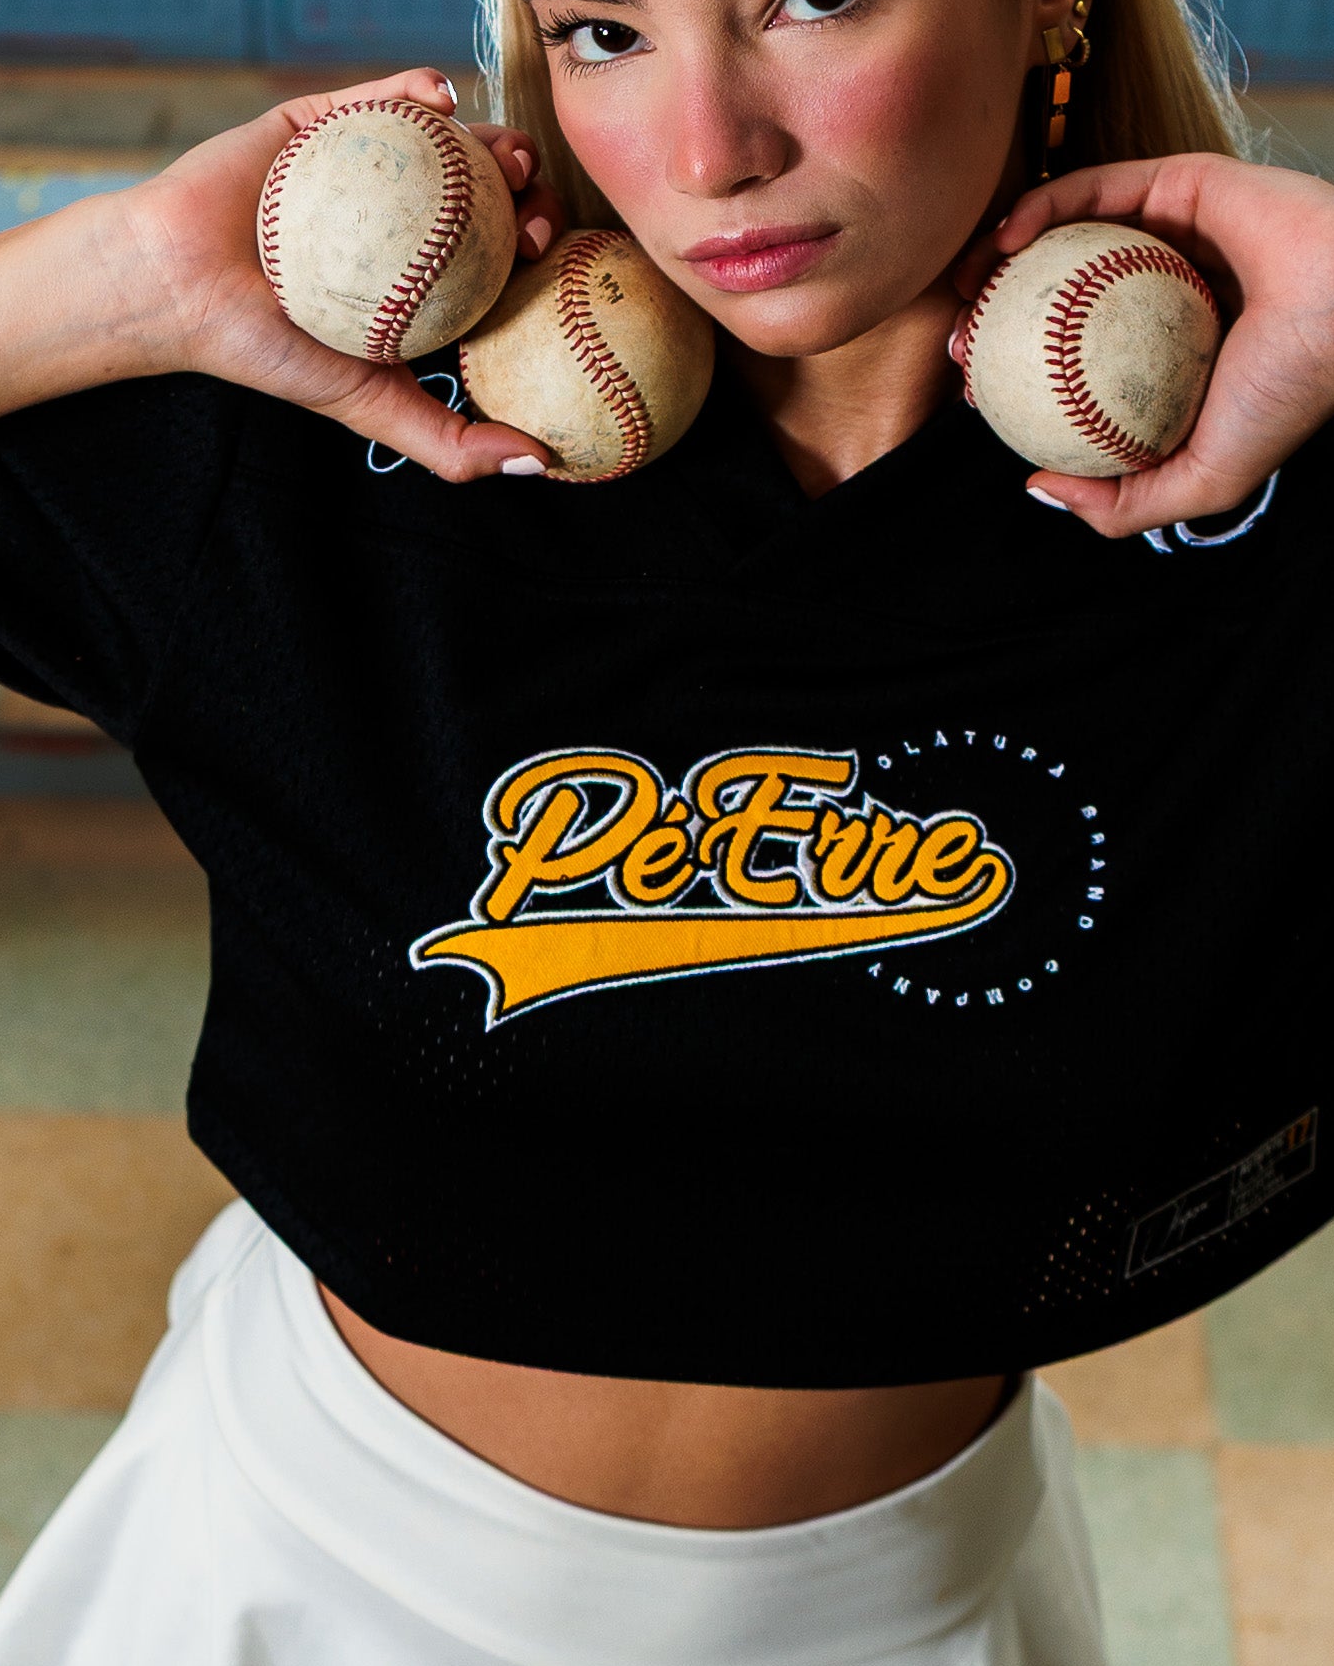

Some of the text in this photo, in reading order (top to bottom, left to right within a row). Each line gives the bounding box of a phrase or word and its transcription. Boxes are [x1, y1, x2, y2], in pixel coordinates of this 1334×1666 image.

[868, 729, 1107, 1007] OLATURA BRAND COMPANY
